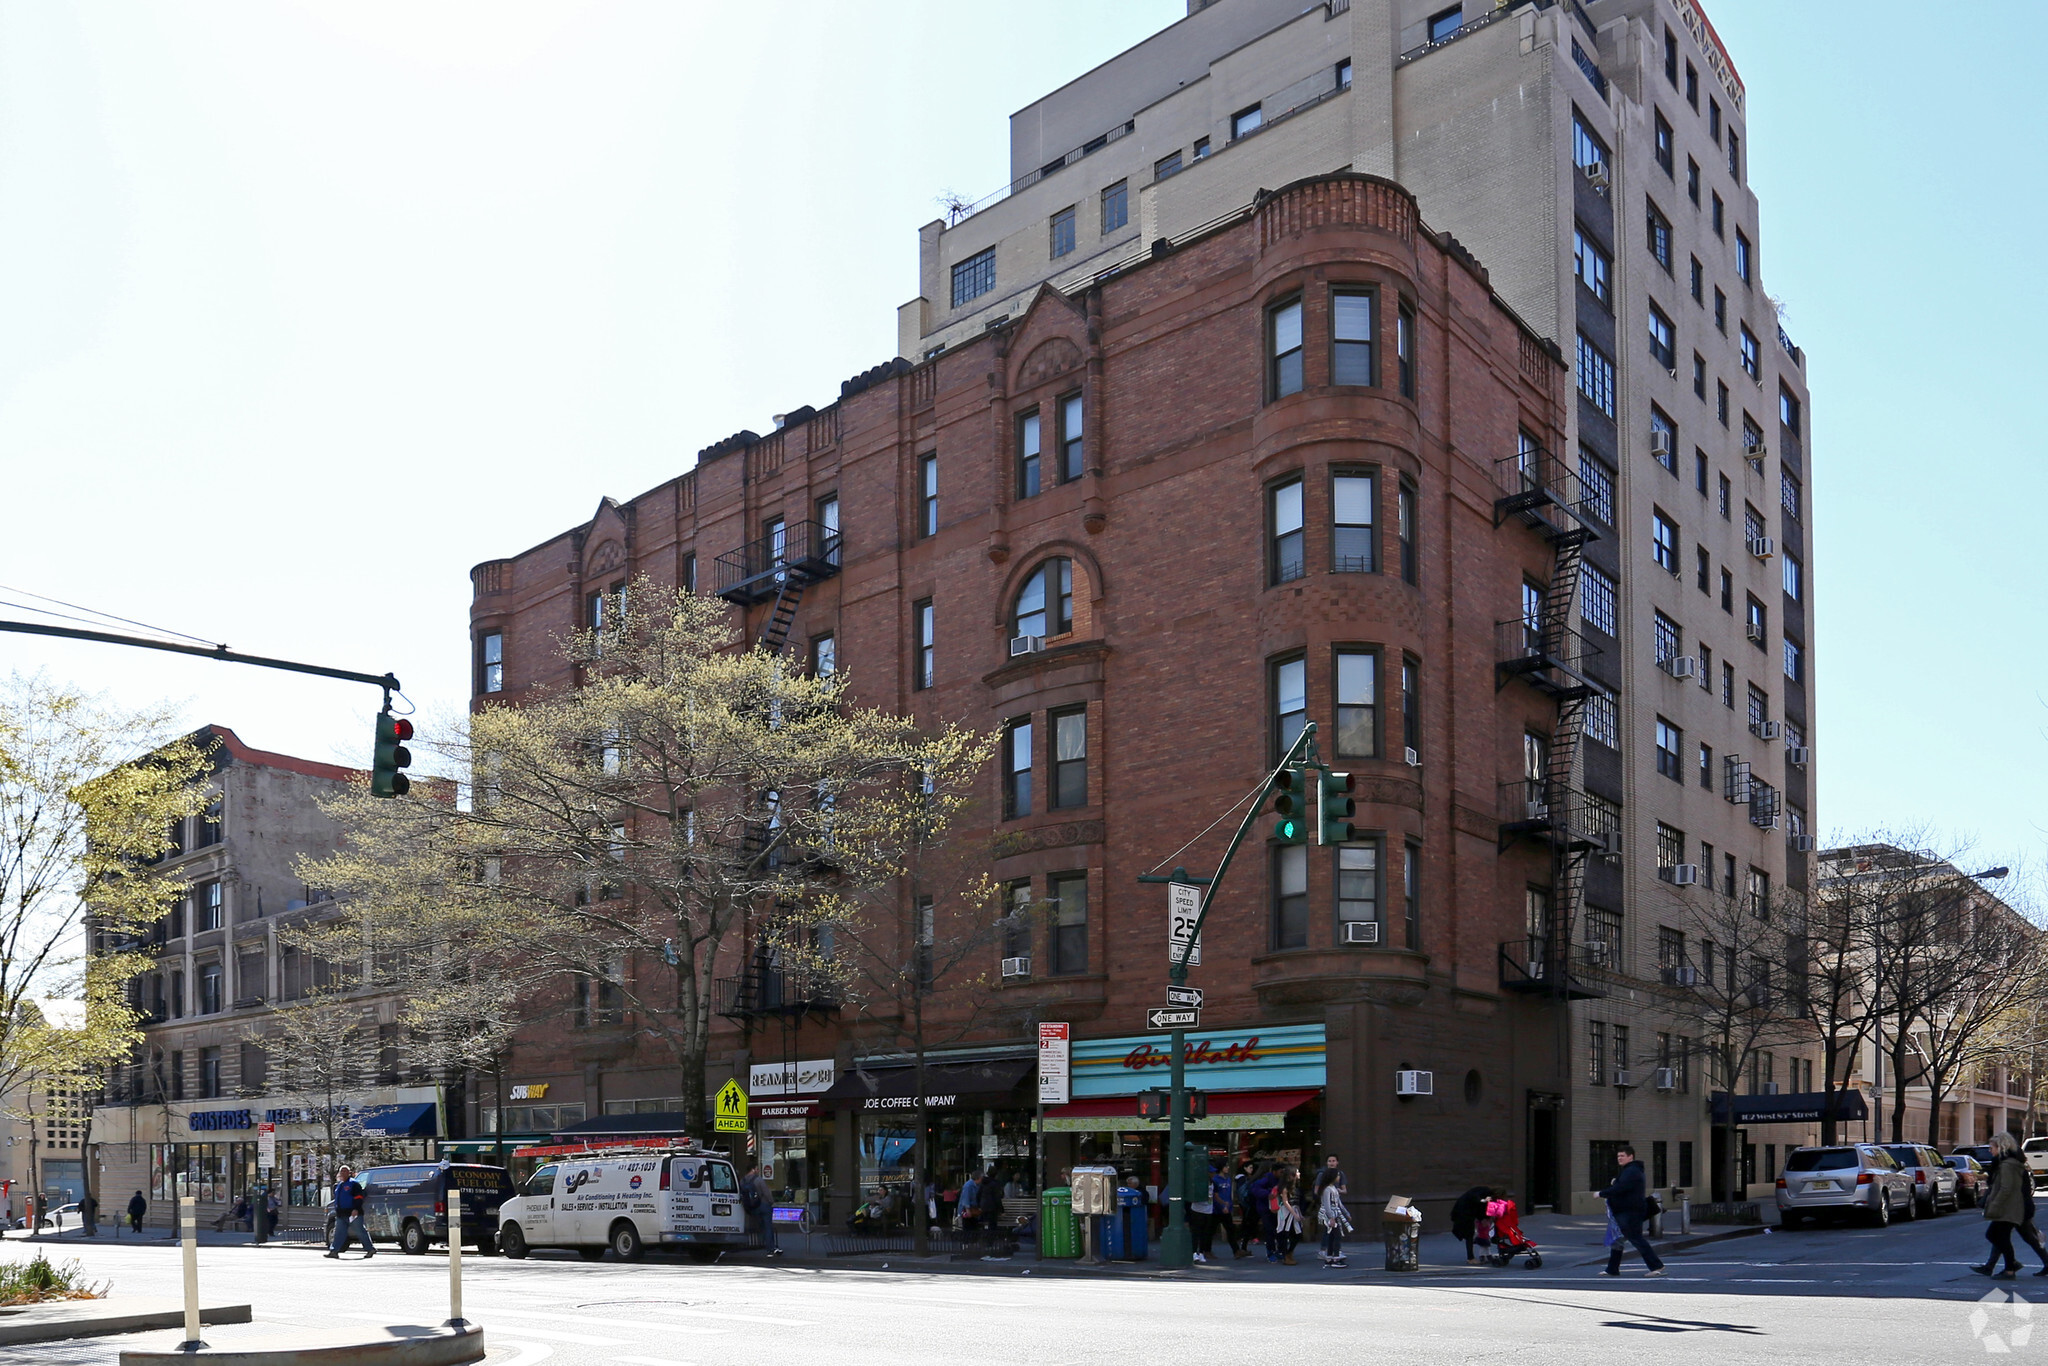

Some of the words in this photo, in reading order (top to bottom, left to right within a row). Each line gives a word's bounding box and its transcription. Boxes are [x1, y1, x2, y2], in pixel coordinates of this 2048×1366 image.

[1178, 888, 1191, 897] CITY
[1175, 897, 1194, 907] SPEED
[1177, 906, 1192, 916] LIMIT
[1173, 916, 1196, 939] 25
[1170, 992, 1182, 1001] ONE
[1186, 993, 1198, 1002] WAY
[1156, 1014, 1172, 1022] ONE
[1175, 1013, 1192, 1022] WAY
[509, 1083, 550, 1100] SUBWAY
[863, 1098, 879, 1109] JOE
[880, 1096, 911, 1108] COFFEE
[912, 1095, 957, 1107] CMPANY
[761, 1107, 789, 1116] BARBER
[790, 1106, 809, 1115] SHOP
[189, 1109, 252, 1131] GRISTEDES
[717, 1120, 745, 1129] AHEAD
[452, 1170, 502, 1181] ECONOMY
[456, 1178, 482, 1188] FUEL
[585, 1193, 616, 1201] Conditioning
[621, 1192, 643, 1201] Heating
[561, 1203, 574, 1212] SALES
[577, 1203, 594, 1211] SERVICE
[598, 1202, 628, 1210] INSTALLATION
[674, 1224, 707, 1232] RESIDENTIAL
